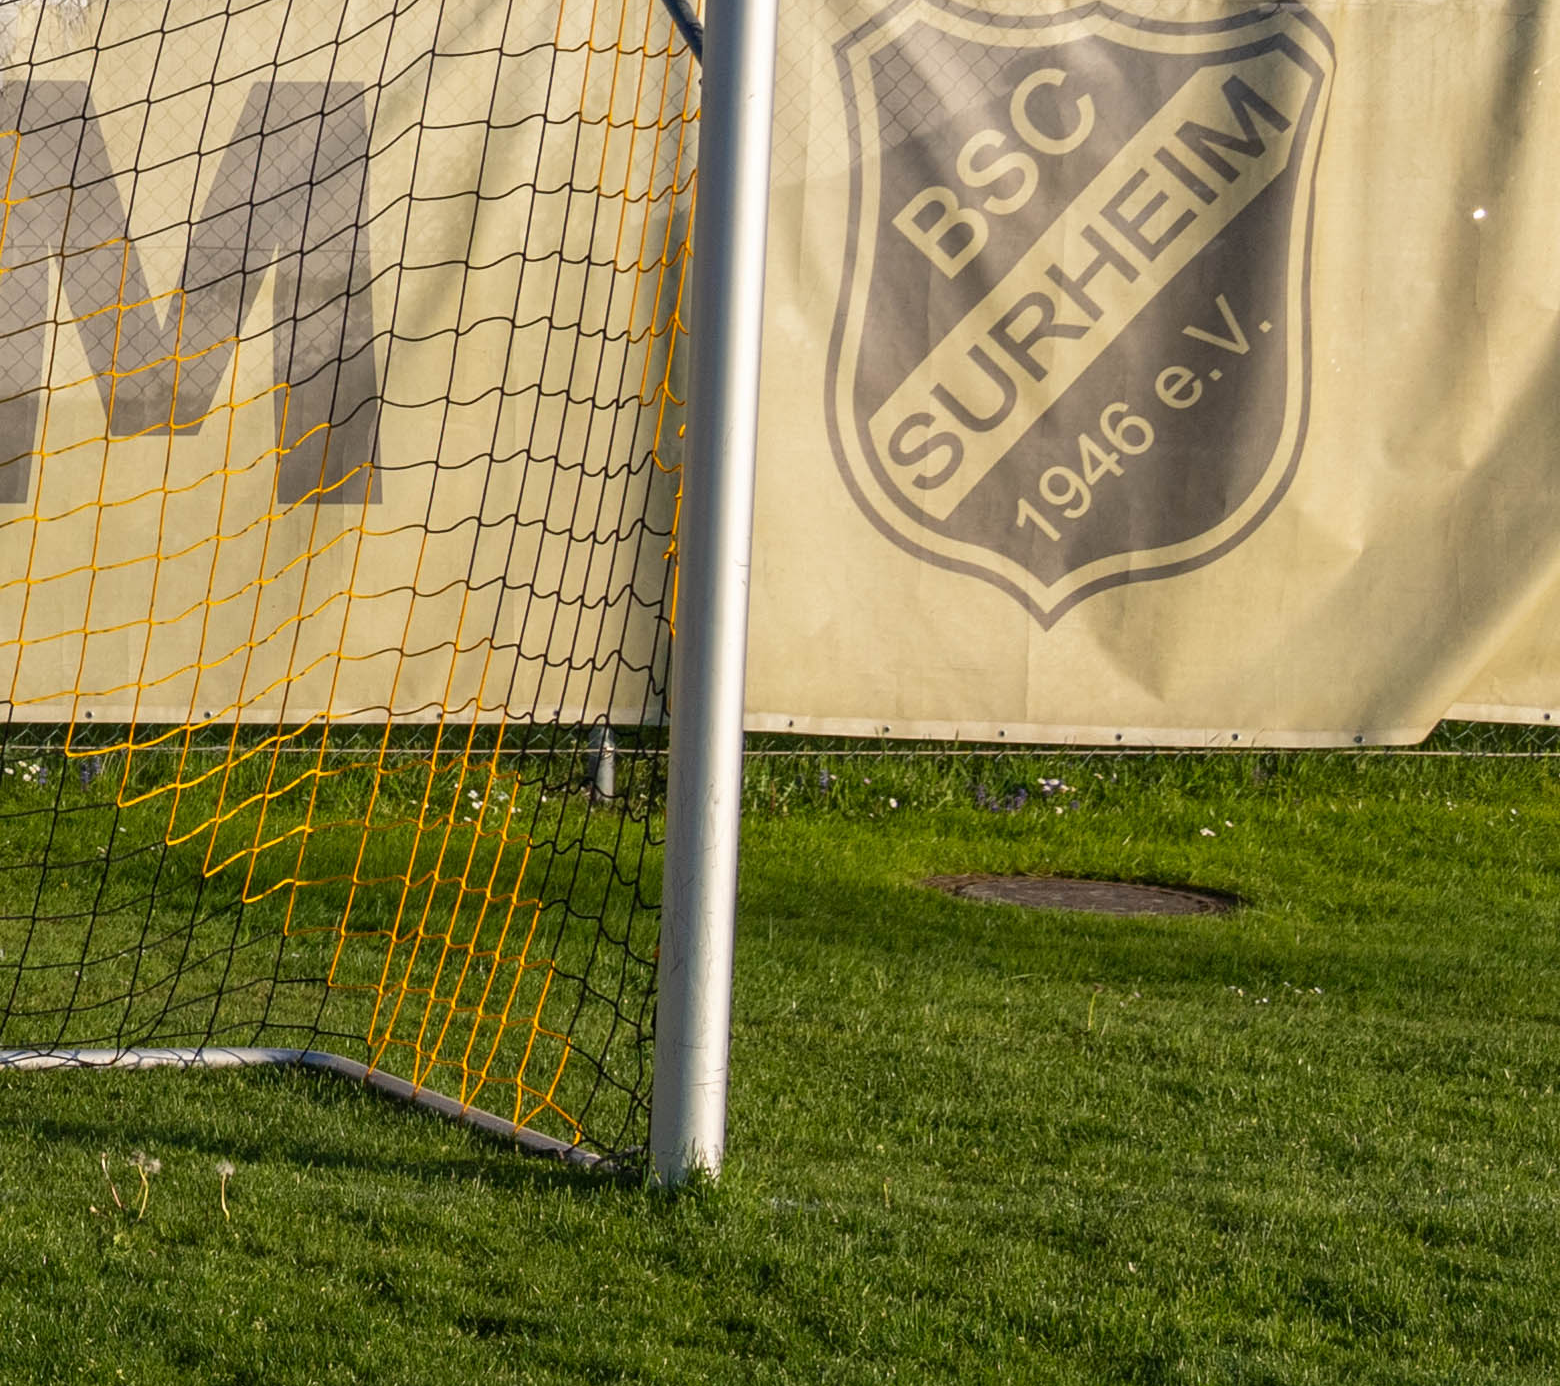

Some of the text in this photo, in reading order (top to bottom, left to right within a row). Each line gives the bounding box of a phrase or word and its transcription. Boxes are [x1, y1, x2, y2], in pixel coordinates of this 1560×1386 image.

[888, 74, 1293, 490] SURHEIM
[892, 68, 1095, 279] BSC
[1015, 294, 1273, 542] 1946 e.V.
